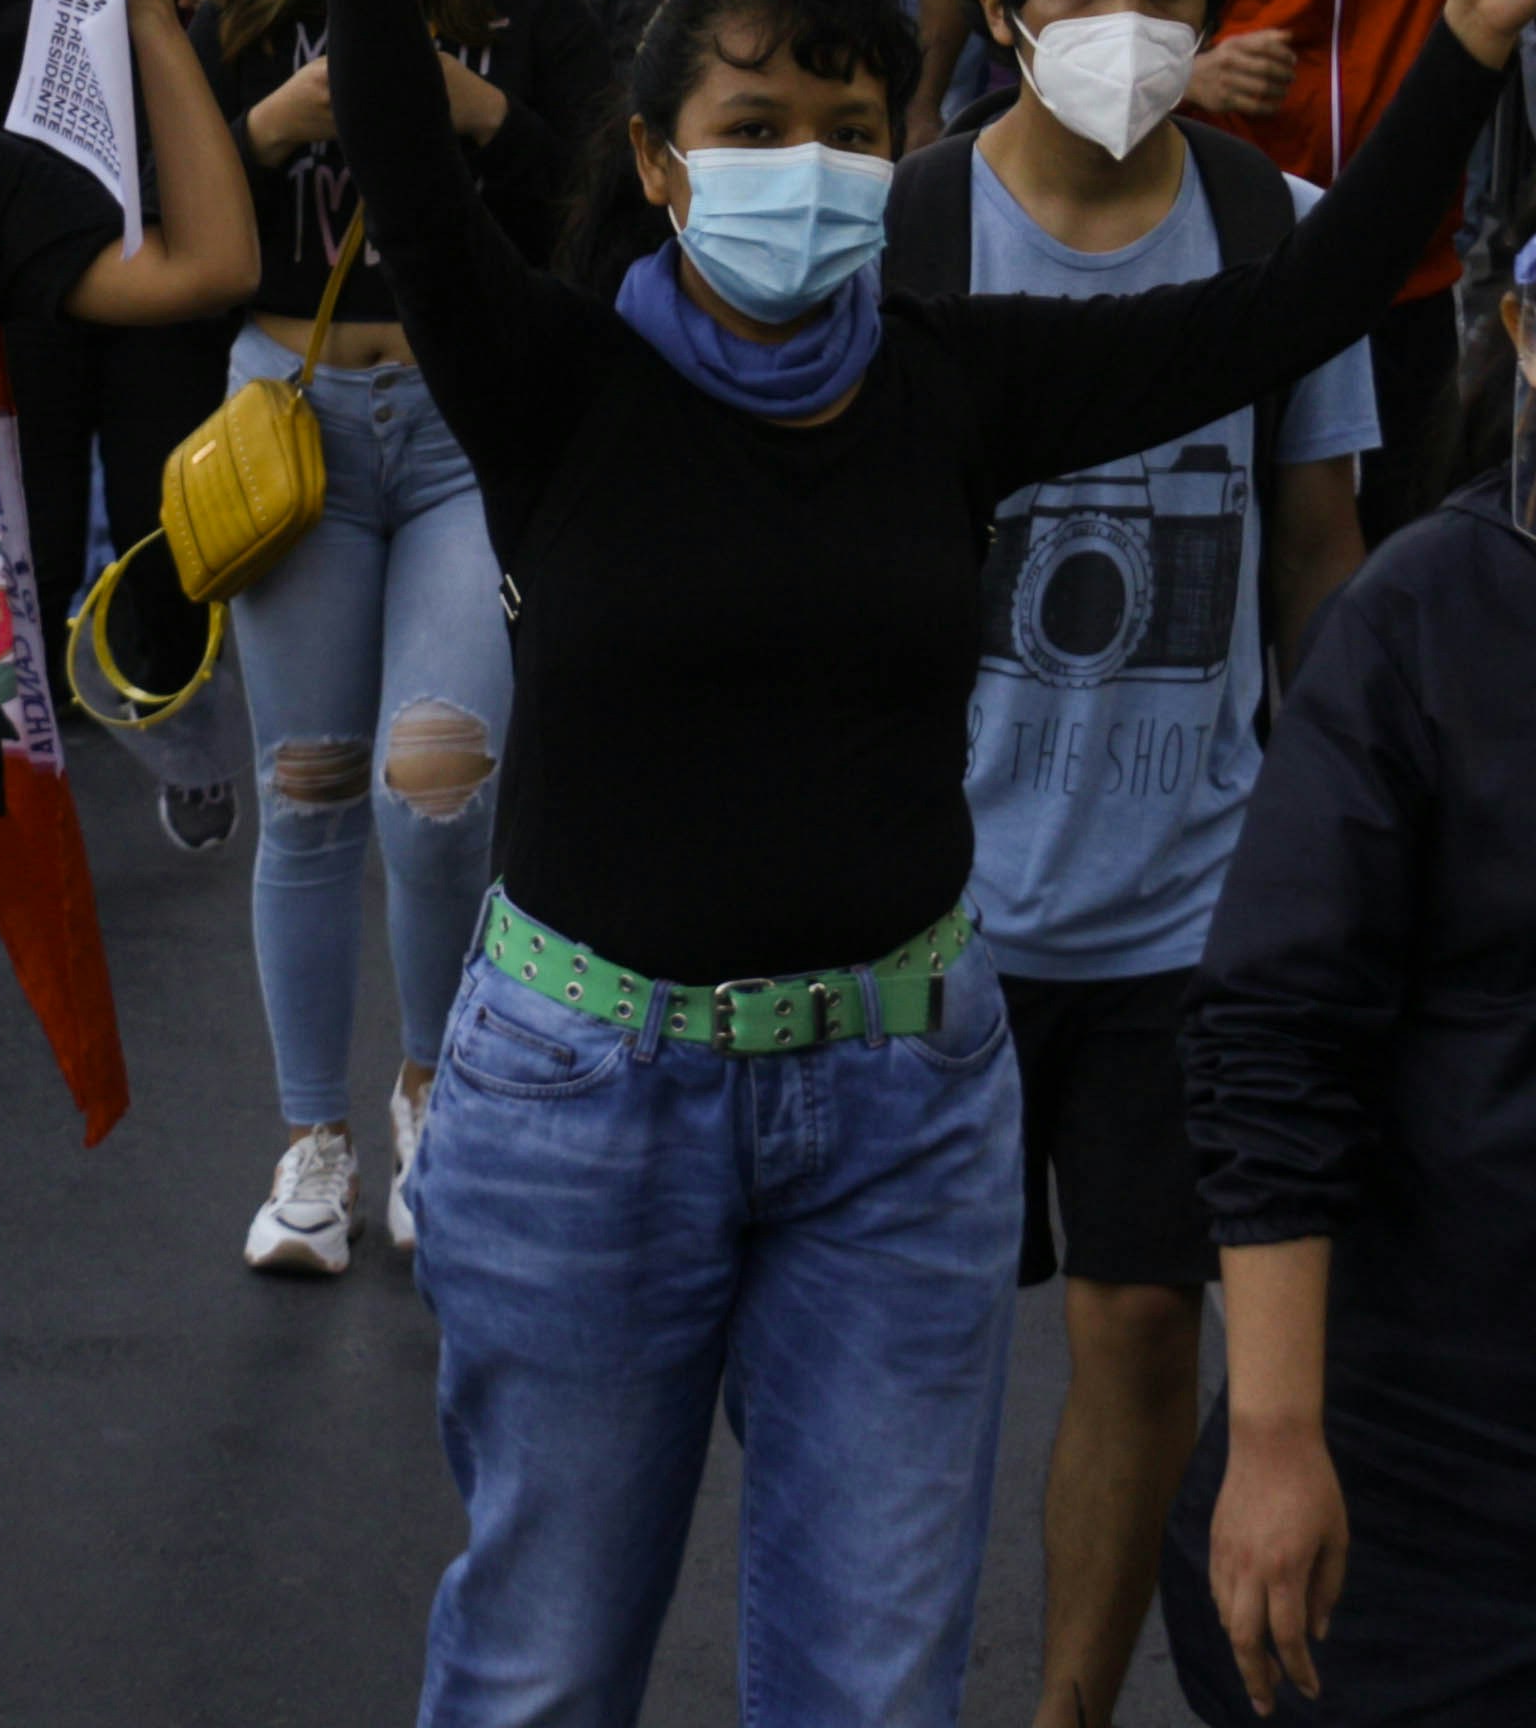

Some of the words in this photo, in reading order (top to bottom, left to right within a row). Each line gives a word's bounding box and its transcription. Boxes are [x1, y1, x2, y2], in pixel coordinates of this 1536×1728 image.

[32, 10, 70, 128] PRESIDENTE
[1012, 718, 1082, 794] THE
[1106, 716, 1212, 797] SHOT
